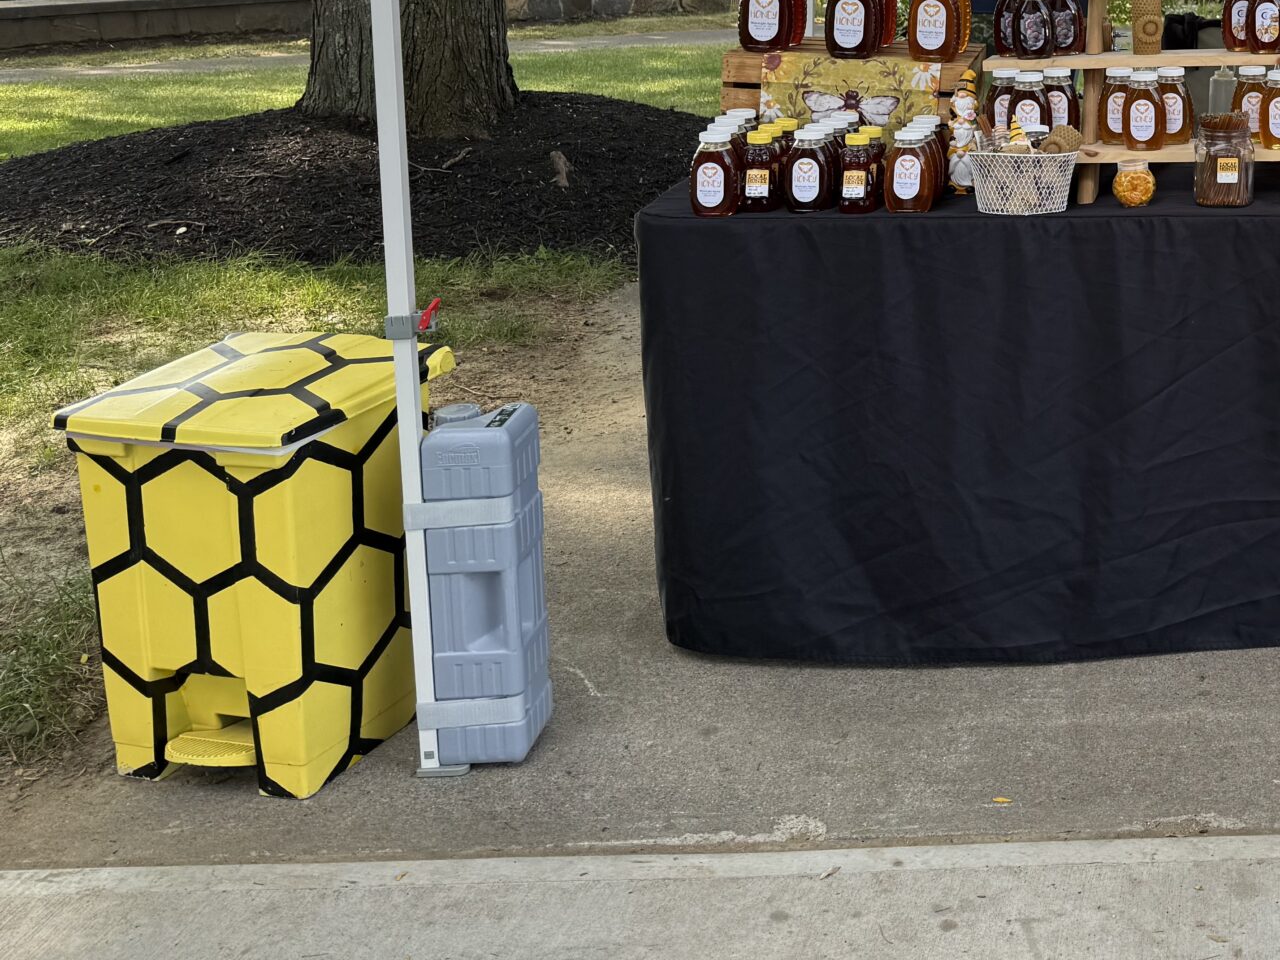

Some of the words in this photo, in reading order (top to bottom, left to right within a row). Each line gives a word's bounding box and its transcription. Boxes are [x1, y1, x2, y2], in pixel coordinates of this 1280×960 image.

[750, 9, 778, 19] HONEY
[835, 16, 863, 26] HONEY
[918, 16, 945, 28] HONEY
